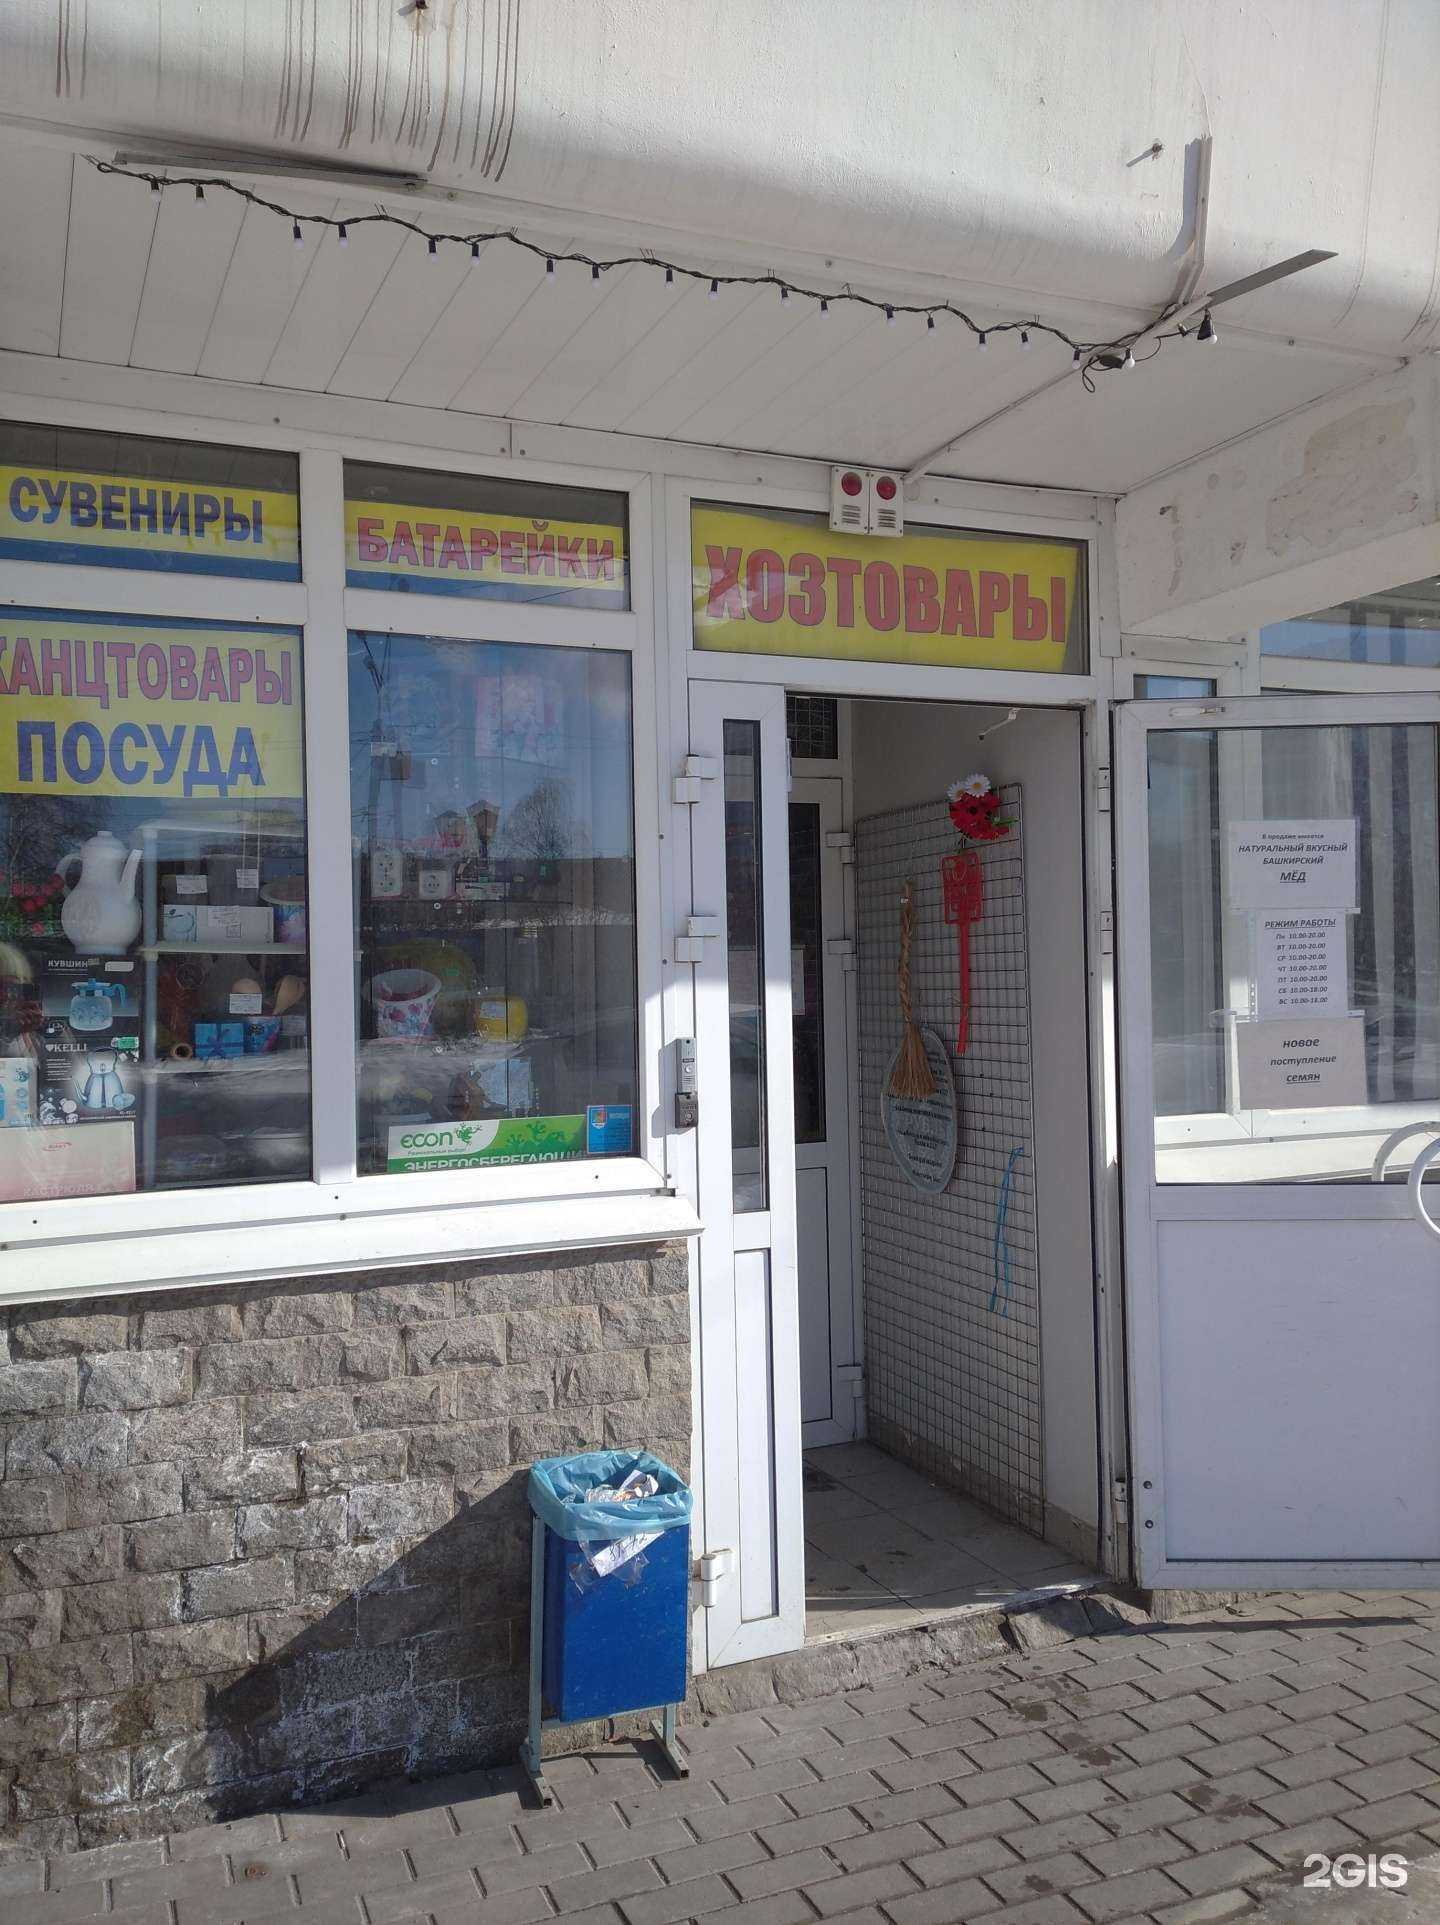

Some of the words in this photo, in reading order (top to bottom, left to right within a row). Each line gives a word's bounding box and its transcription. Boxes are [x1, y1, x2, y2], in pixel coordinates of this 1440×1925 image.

[9, 476, 263, 544] СУВЕНИРЫ
[357, 517, 615, 581] БАТАРЕЙКИ
[704, 545, 1066, 643] ХОЗТОВАРЫ
[17, 720, 266, 798] ПОСУДА
[1238, 842, 1304, 853] НАТУРАЛЬНЫЙ
[1305, 842, 1348, 852] ВКУСНЫЙ
[1262, 855, 1324, 865] БАШКИРСКИЙ
[1279, 869, 1306, 883] МЁД
[1264, 920, 1298, 929] РЕЖИМ
[1300, 918, 1336, 927] РАБОТЫ
[47, 959, 89, 969] КУВШИН
[54, 1043, 88, 1052] KELLI
[1282, 1039, 1320, 1049] новое
[1270, 1055, 1337, 1067] поступление
[1286, 1073, 1321, 1084] семян
[400, 1131, 453, 1149] econ
